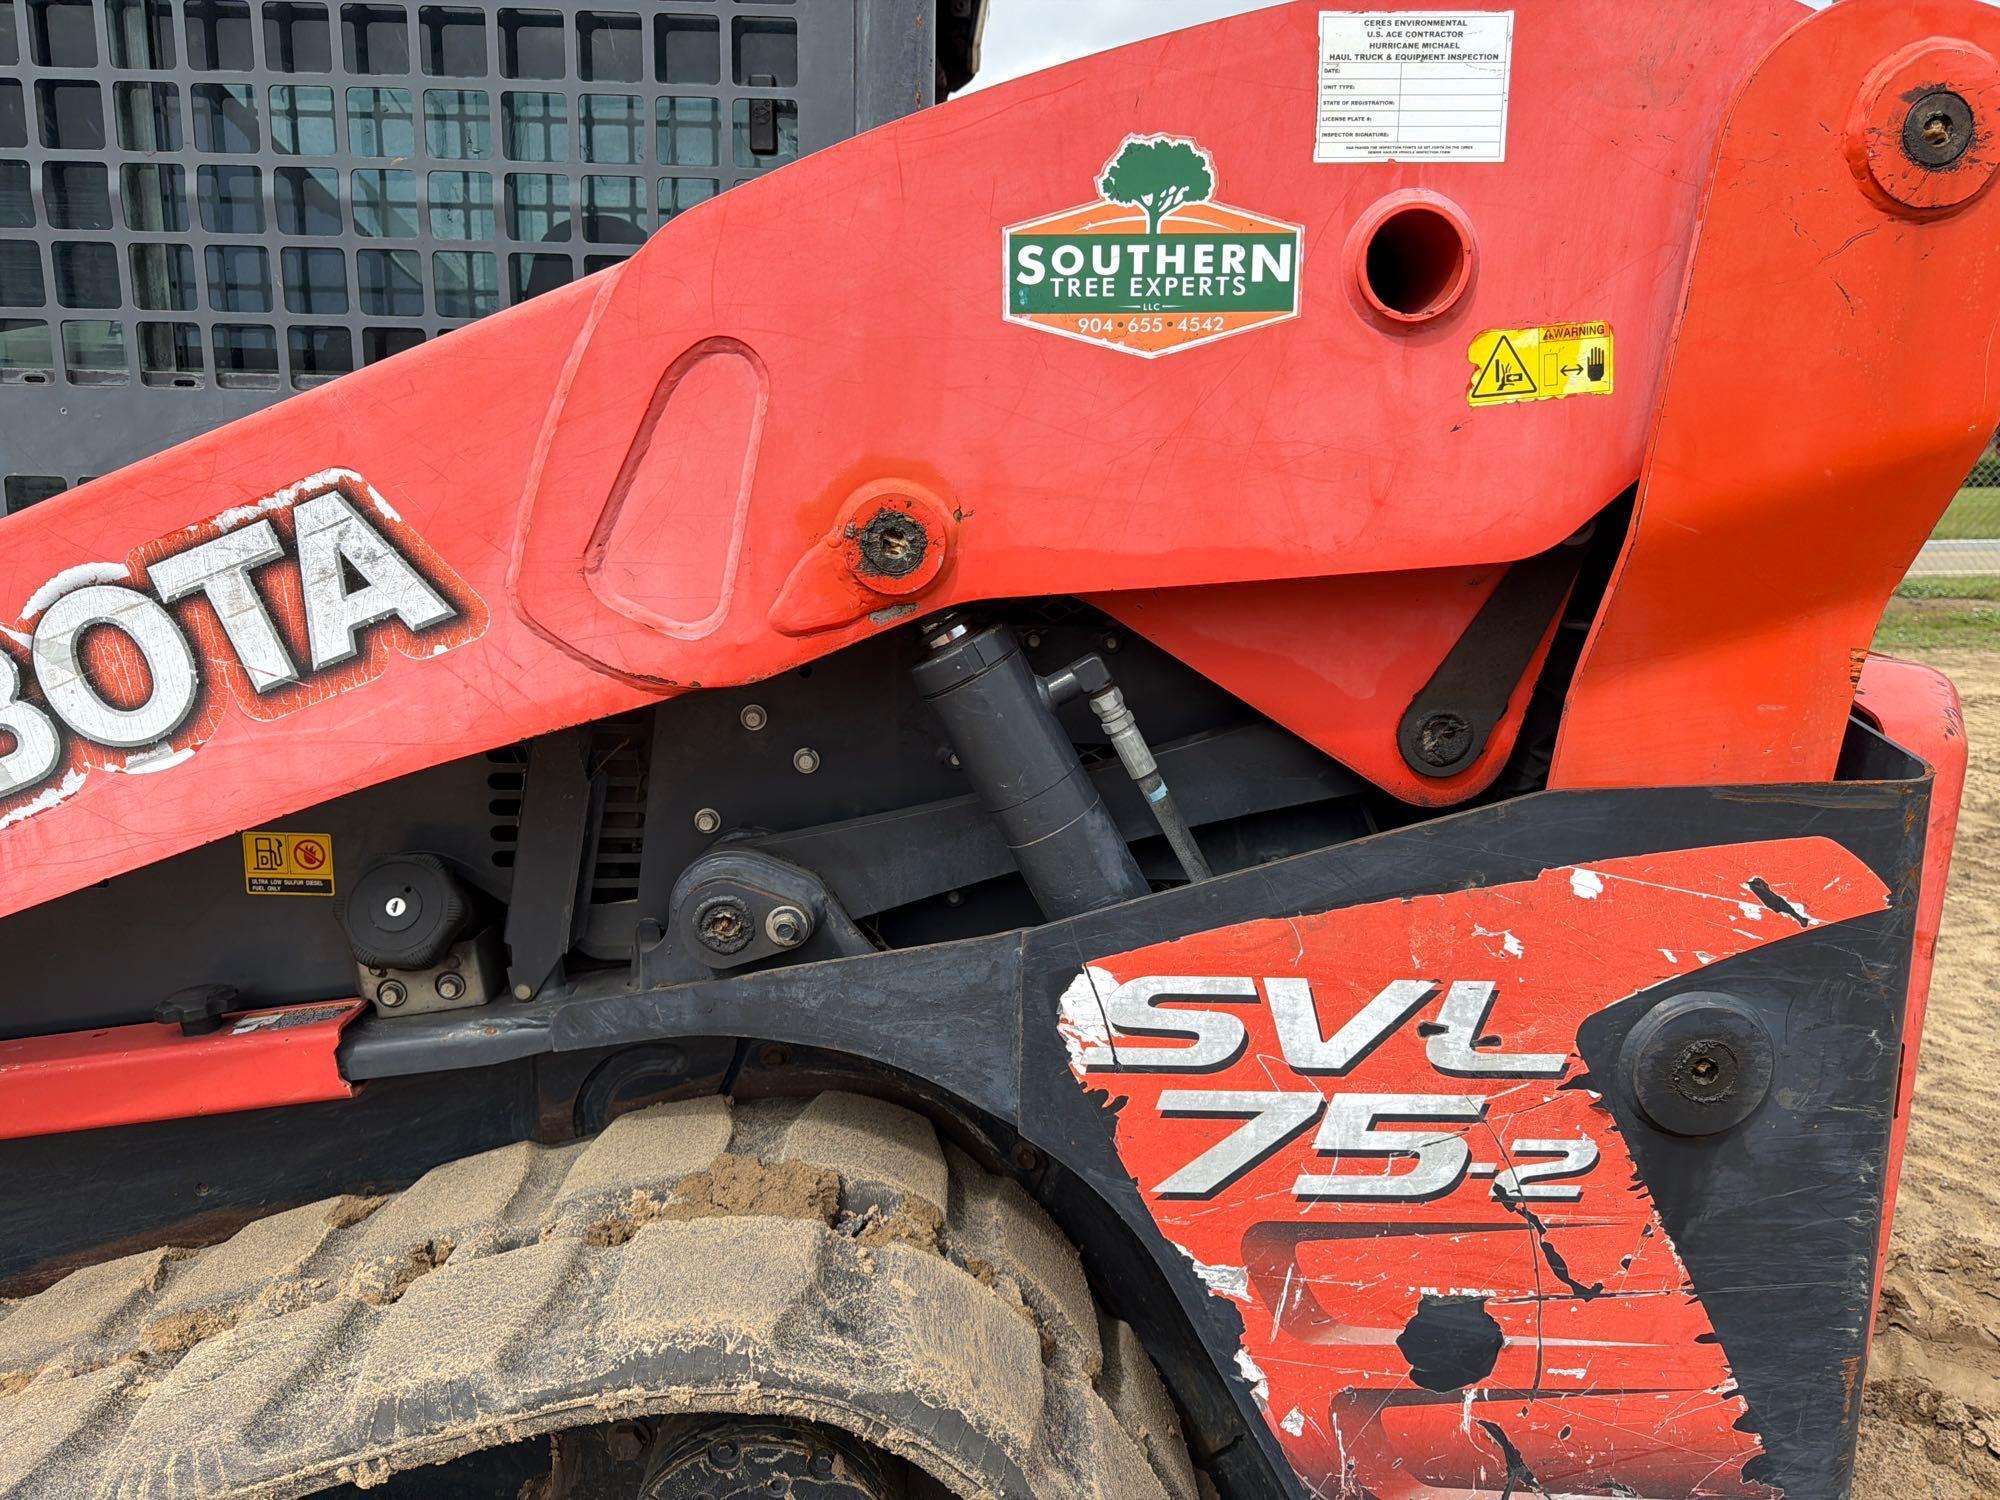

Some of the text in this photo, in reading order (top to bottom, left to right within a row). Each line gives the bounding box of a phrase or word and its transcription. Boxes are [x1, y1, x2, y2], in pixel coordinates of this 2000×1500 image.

[1364, 19, 1468, 27] CERES ENVIRONMENTAL
[1395, 53, 1445, 61] EQUIPMENT
[1016, 243, 1292, 285] SOUTHERN
[1049, 276, 1246, 298] TREE EXPERTS
[1142, 303, 1161, 311] LLC
[1553, 325, 1604, 338] WARNING
[1081, 975, 1572, 1080] SVL
[1149, 1089, 1601, 1203] 75-2
